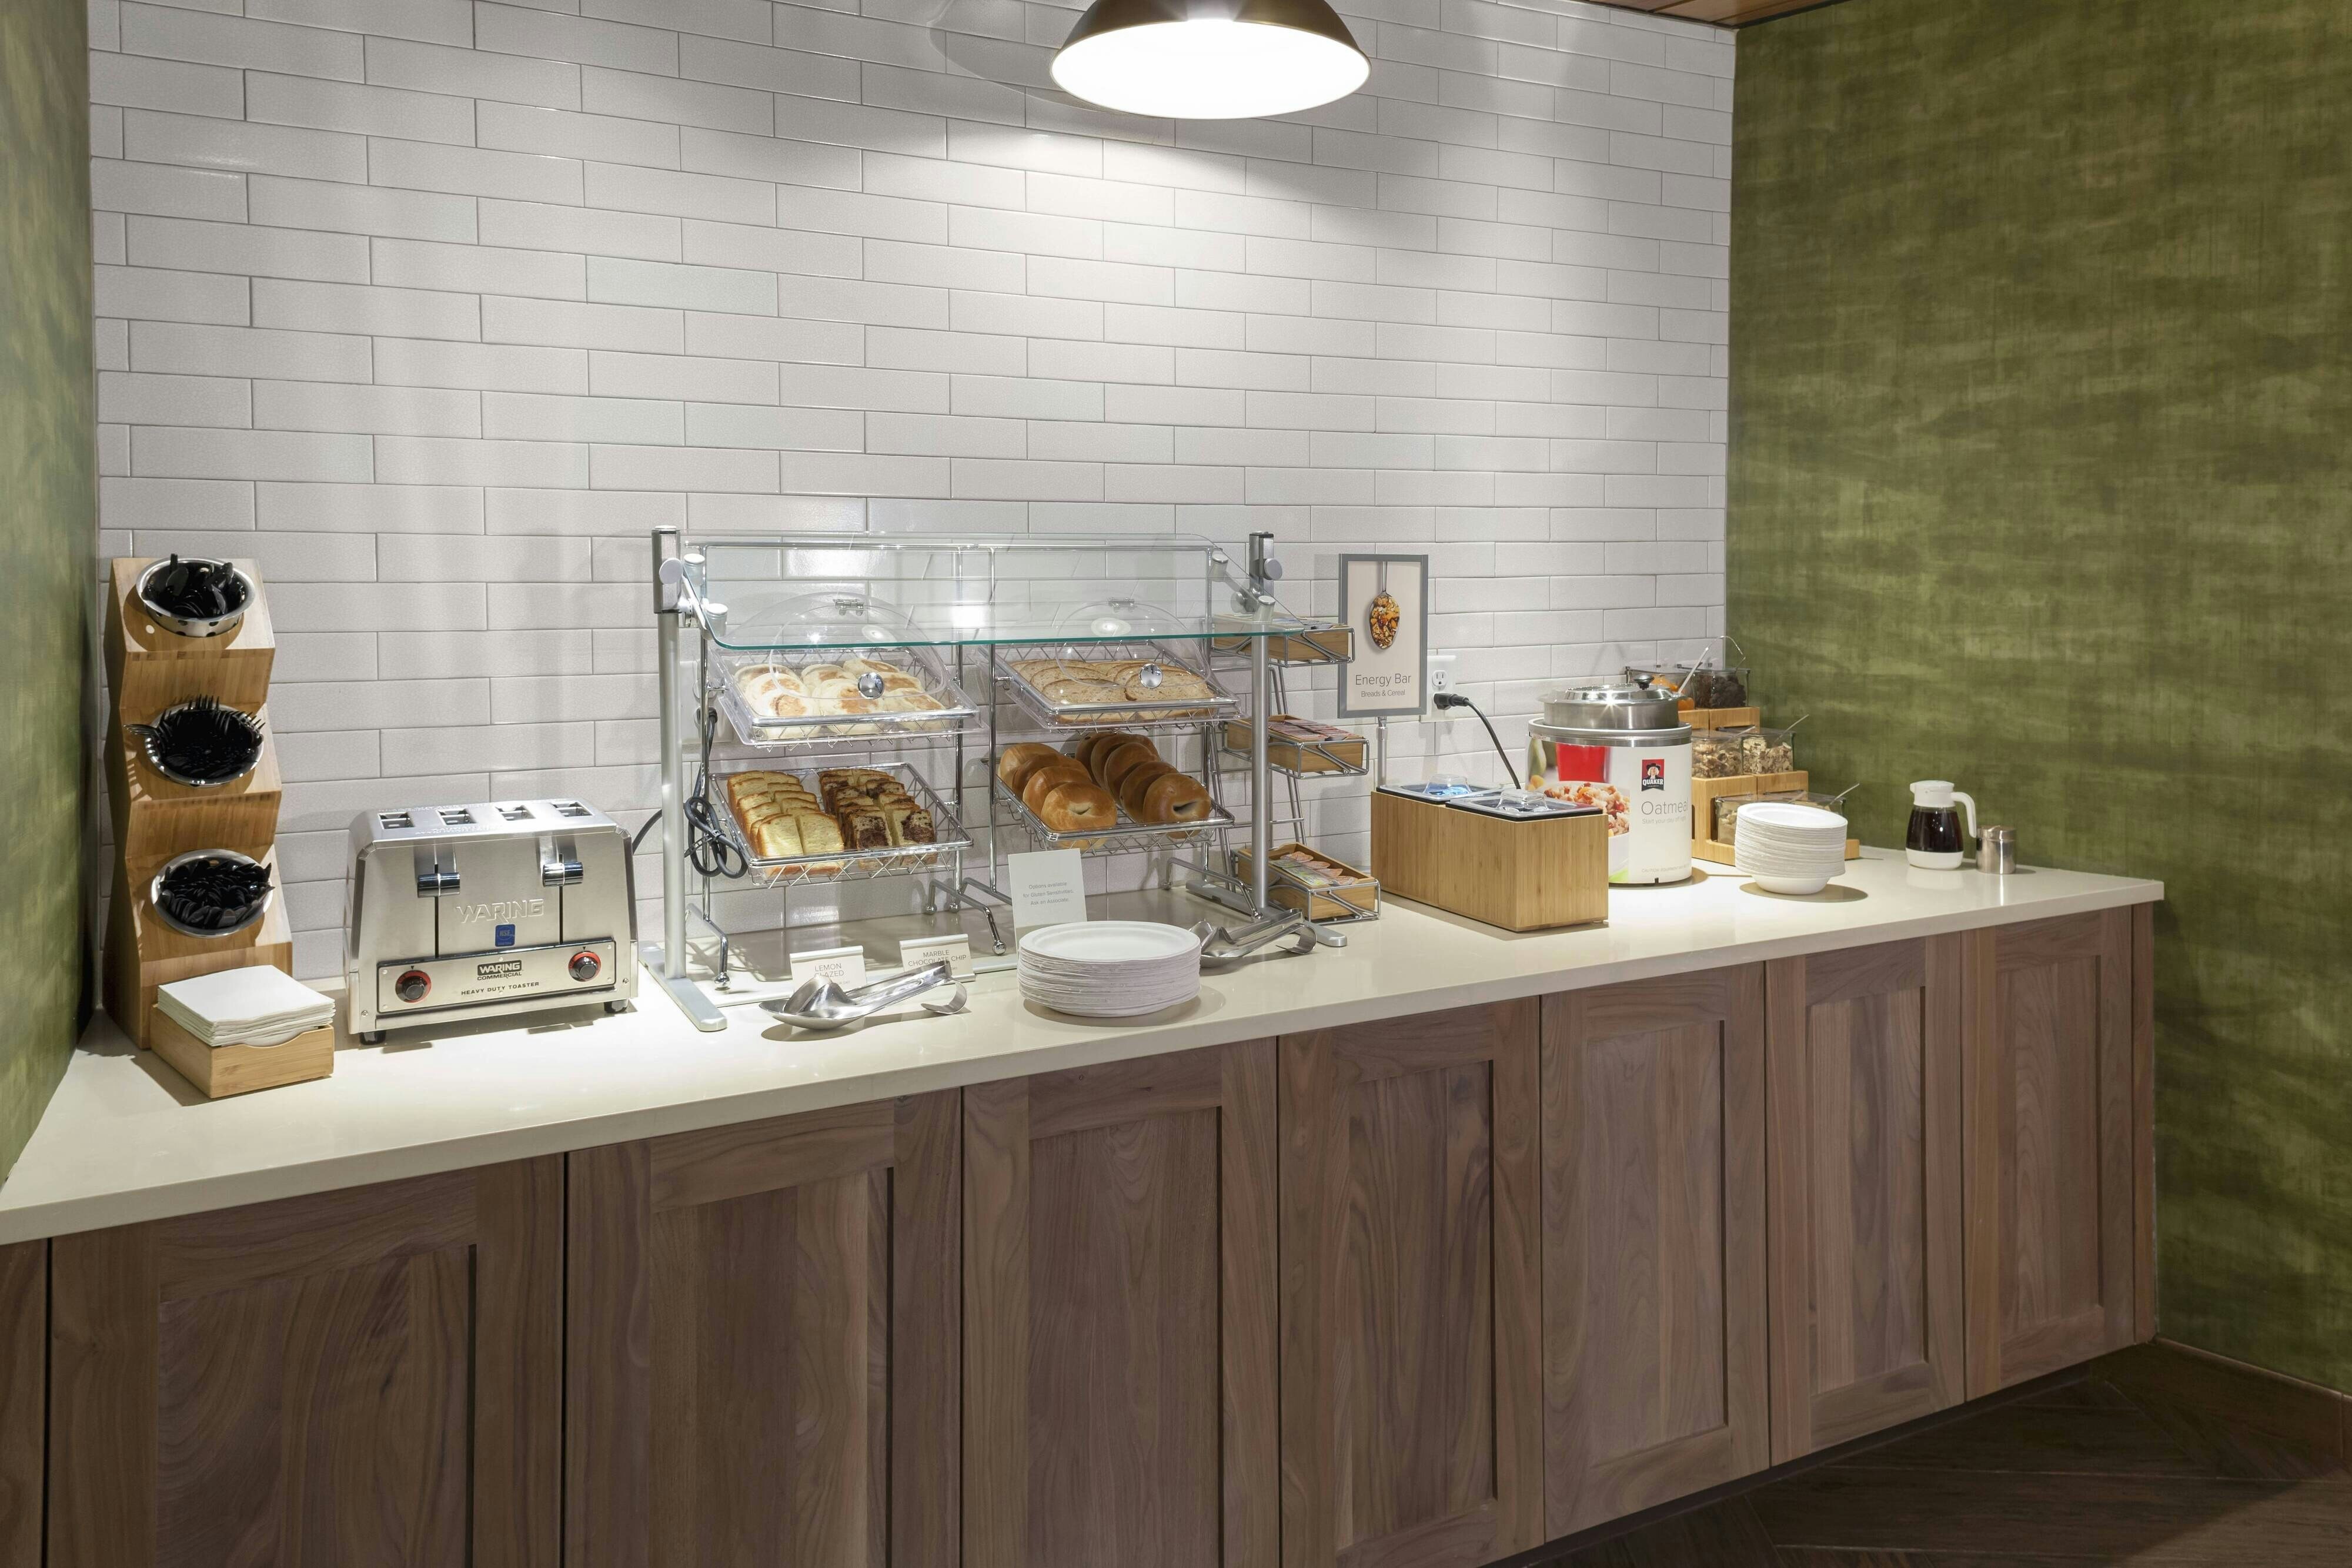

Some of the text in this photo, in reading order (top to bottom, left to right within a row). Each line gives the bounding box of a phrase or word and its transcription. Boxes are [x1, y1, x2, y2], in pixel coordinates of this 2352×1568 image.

[1355, 673, 1411, 687] Energy Bar
[1641, 798, 1689, 815] Oatmeal
[456, 898, 544, 924] WARING
[923, 950, 950, 958] MARBLE
[479, 962, 521, 974] WARING
[814, 963, 842, 972] LEMON
[477, 971, 522, 981] COMMERCIAL
[508, 981, 540, 990] TOASTER
